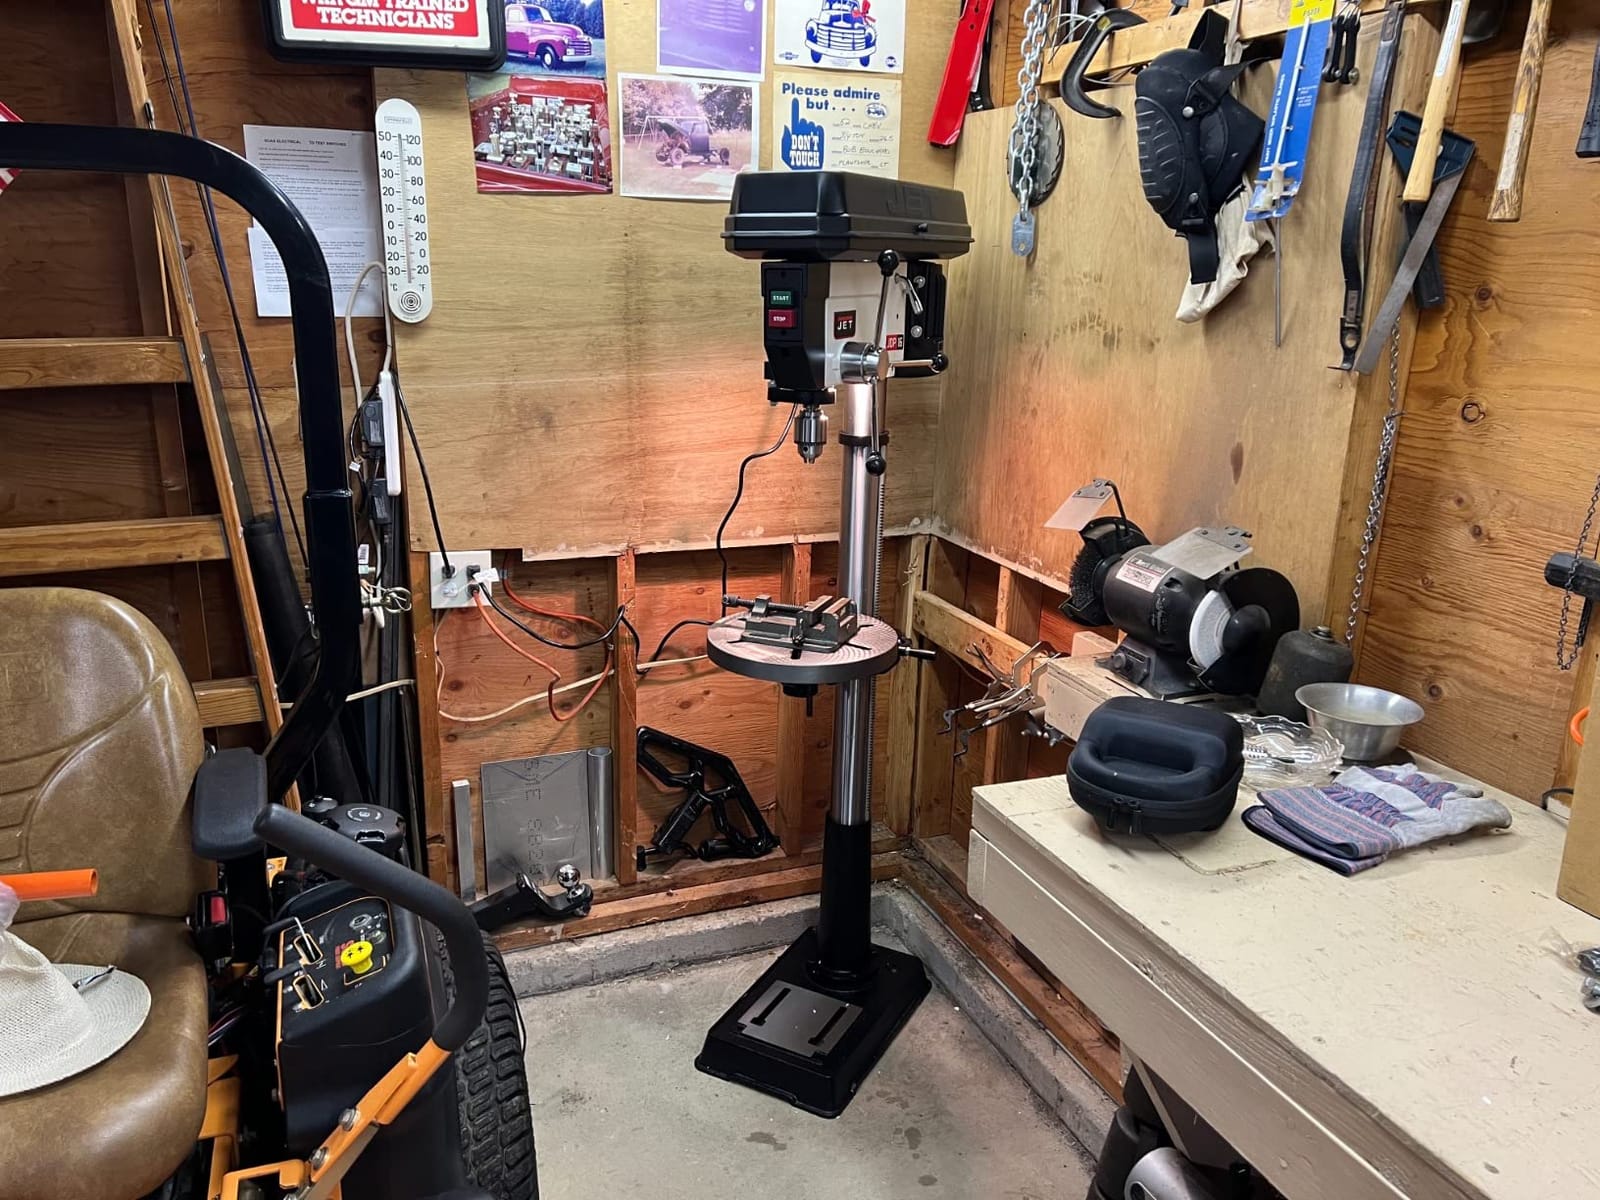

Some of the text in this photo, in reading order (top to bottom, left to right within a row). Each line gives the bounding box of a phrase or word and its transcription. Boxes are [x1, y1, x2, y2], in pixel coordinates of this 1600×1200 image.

[316, 8, 454, 29] TECHNICIANS
[782, 83, 880, 100] Please admire
[378, 131, 391, 141] 50
[406, 135, 420, 145] 120
[792, 132, 819, 150] DON'T
[380, 151, 392, 160] 40
[790, 151, 819, 166] TOUCH
[407, 156, 422, 166] 100
[382, 169, 393, 178] 30
[411, 177, 423, 186] 80
[383, 187, 394, 196] 20
[412, 196, 424, 205] 60
[385, 204, 394, 213] 10
[414, 214, 425, 223] 40
[388, 221, 394, 229] 0
[387, 236, 397, 245] 10
[415, 232, 426, 241] 20
[387, 252, 399, 261] 20
[419, 249, 426, 258] 0
[388, 266, 400, 275] 30
[417, 265, 428, 274] 20
[837, 320, 852, 330] JET
[887, 338, 896, 348] JDP
